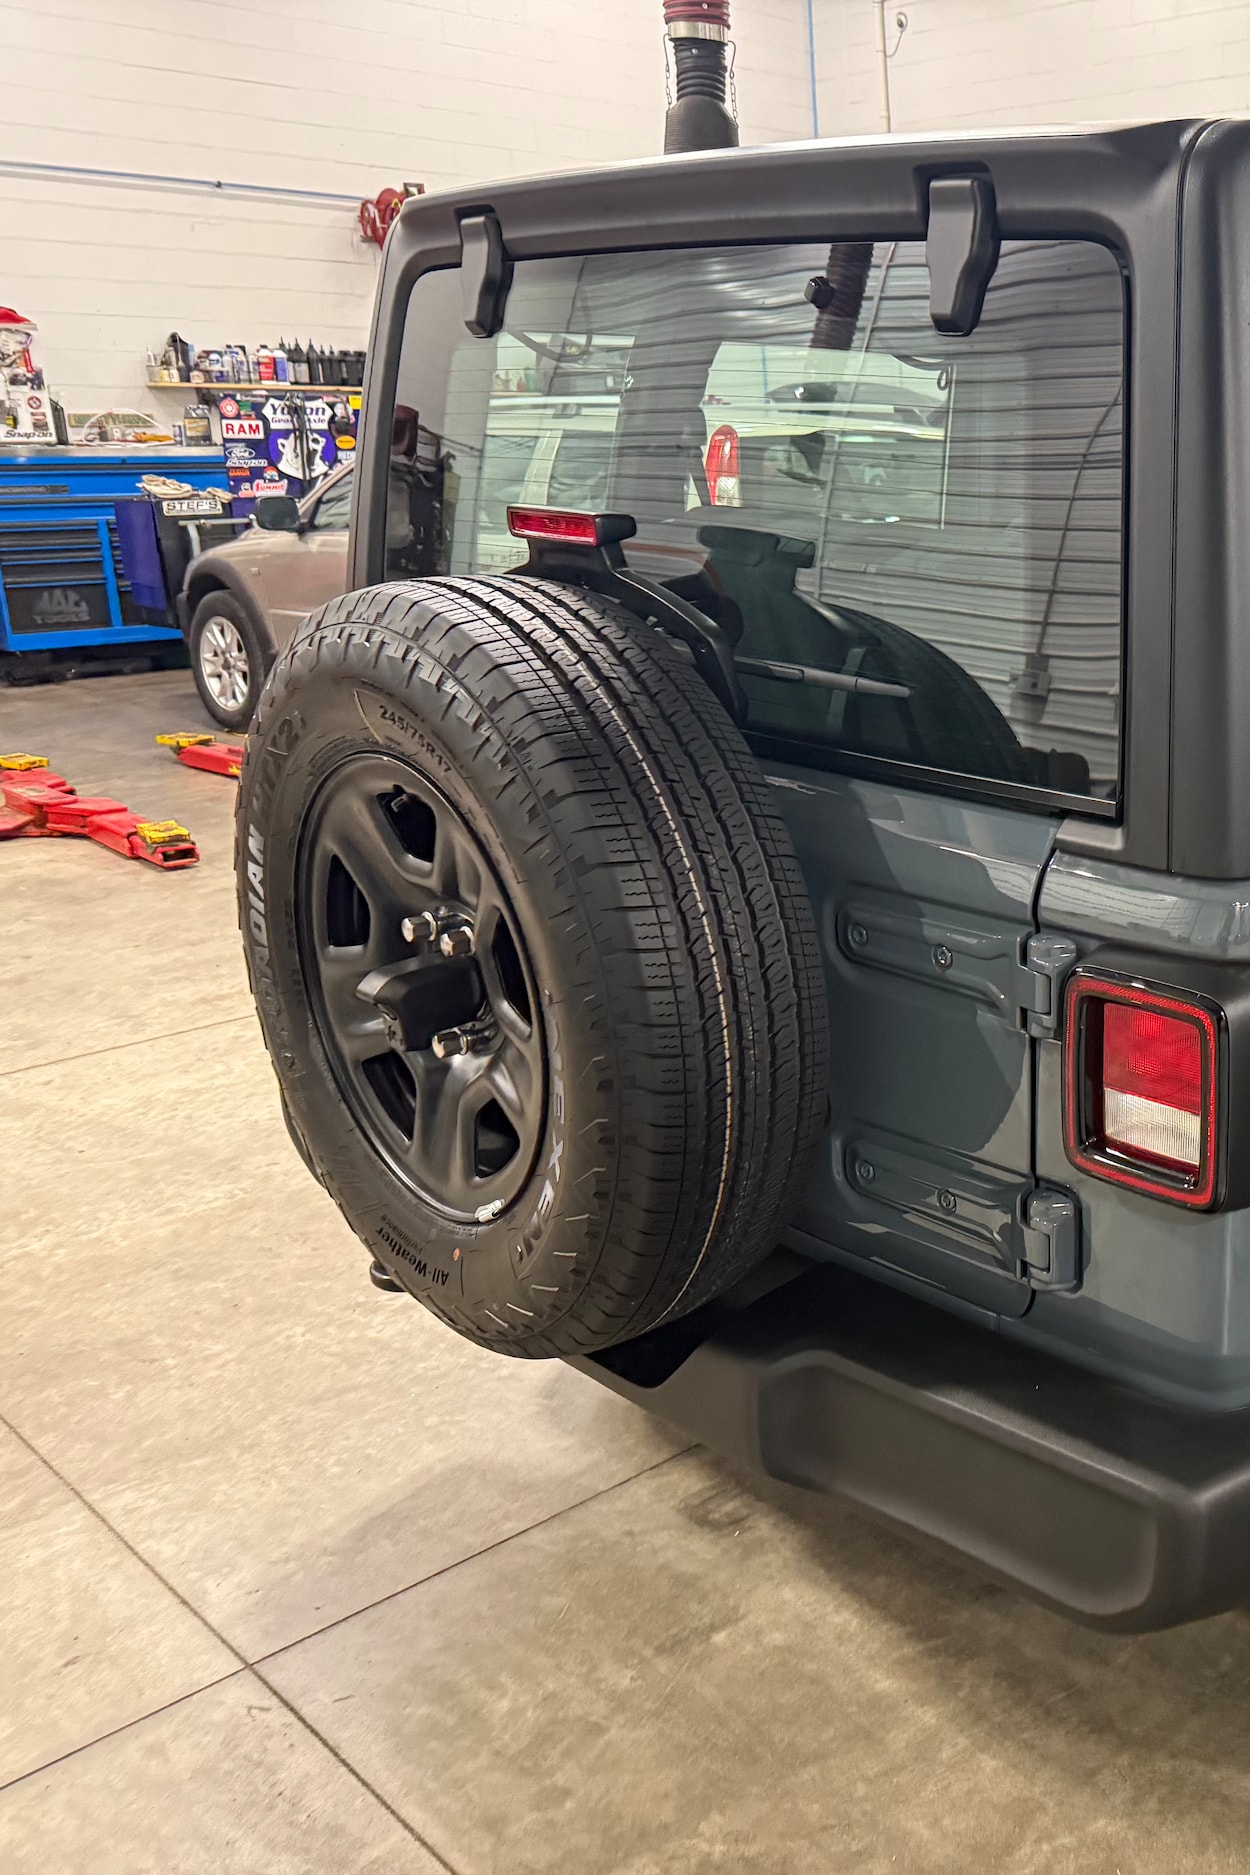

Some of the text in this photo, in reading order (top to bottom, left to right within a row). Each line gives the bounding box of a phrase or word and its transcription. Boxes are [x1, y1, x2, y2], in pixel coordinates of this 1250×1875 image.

[3, 430, 53, 439] Snap-on
[225, 423, 261, 436] RAM
[521, 1017, 565, 1257] NEXEN
[375, 1226, 450, 1287] All-Weather
